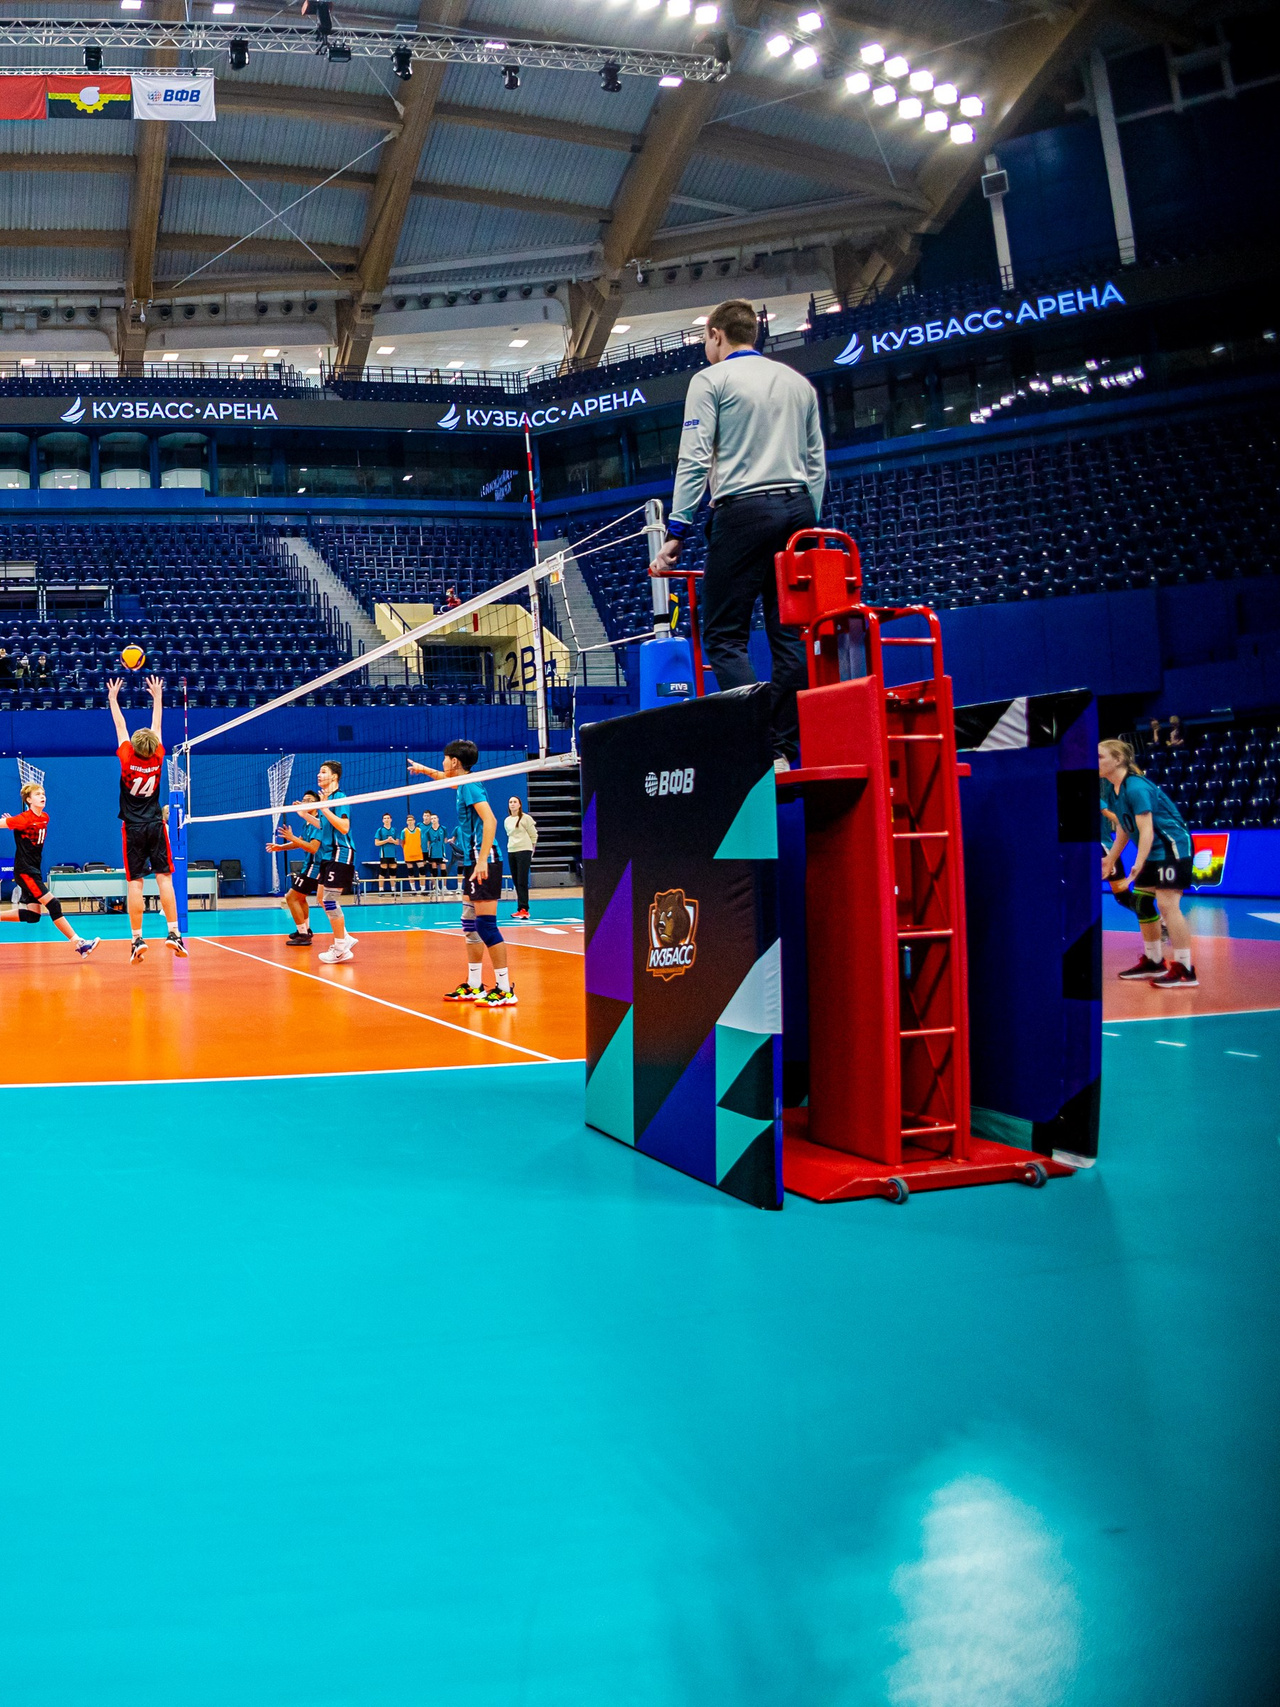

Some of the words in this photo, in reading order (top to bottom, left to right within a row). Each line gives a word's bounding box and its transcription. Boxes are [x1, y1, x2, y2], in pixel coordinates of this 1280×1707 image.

[163, 89, 201, 102] ВФВ
[670, 683, 688, 691] FIVB
[130, 775, 156, 798] 14
[658, 768, 695, 796] ВФВ
[37, 829, 46, 845] 11
[327, 871, 335, 882] 5
[1157, 867, 1176, 881] 10
[649, 945, 694, 967] КУЗБАСС
